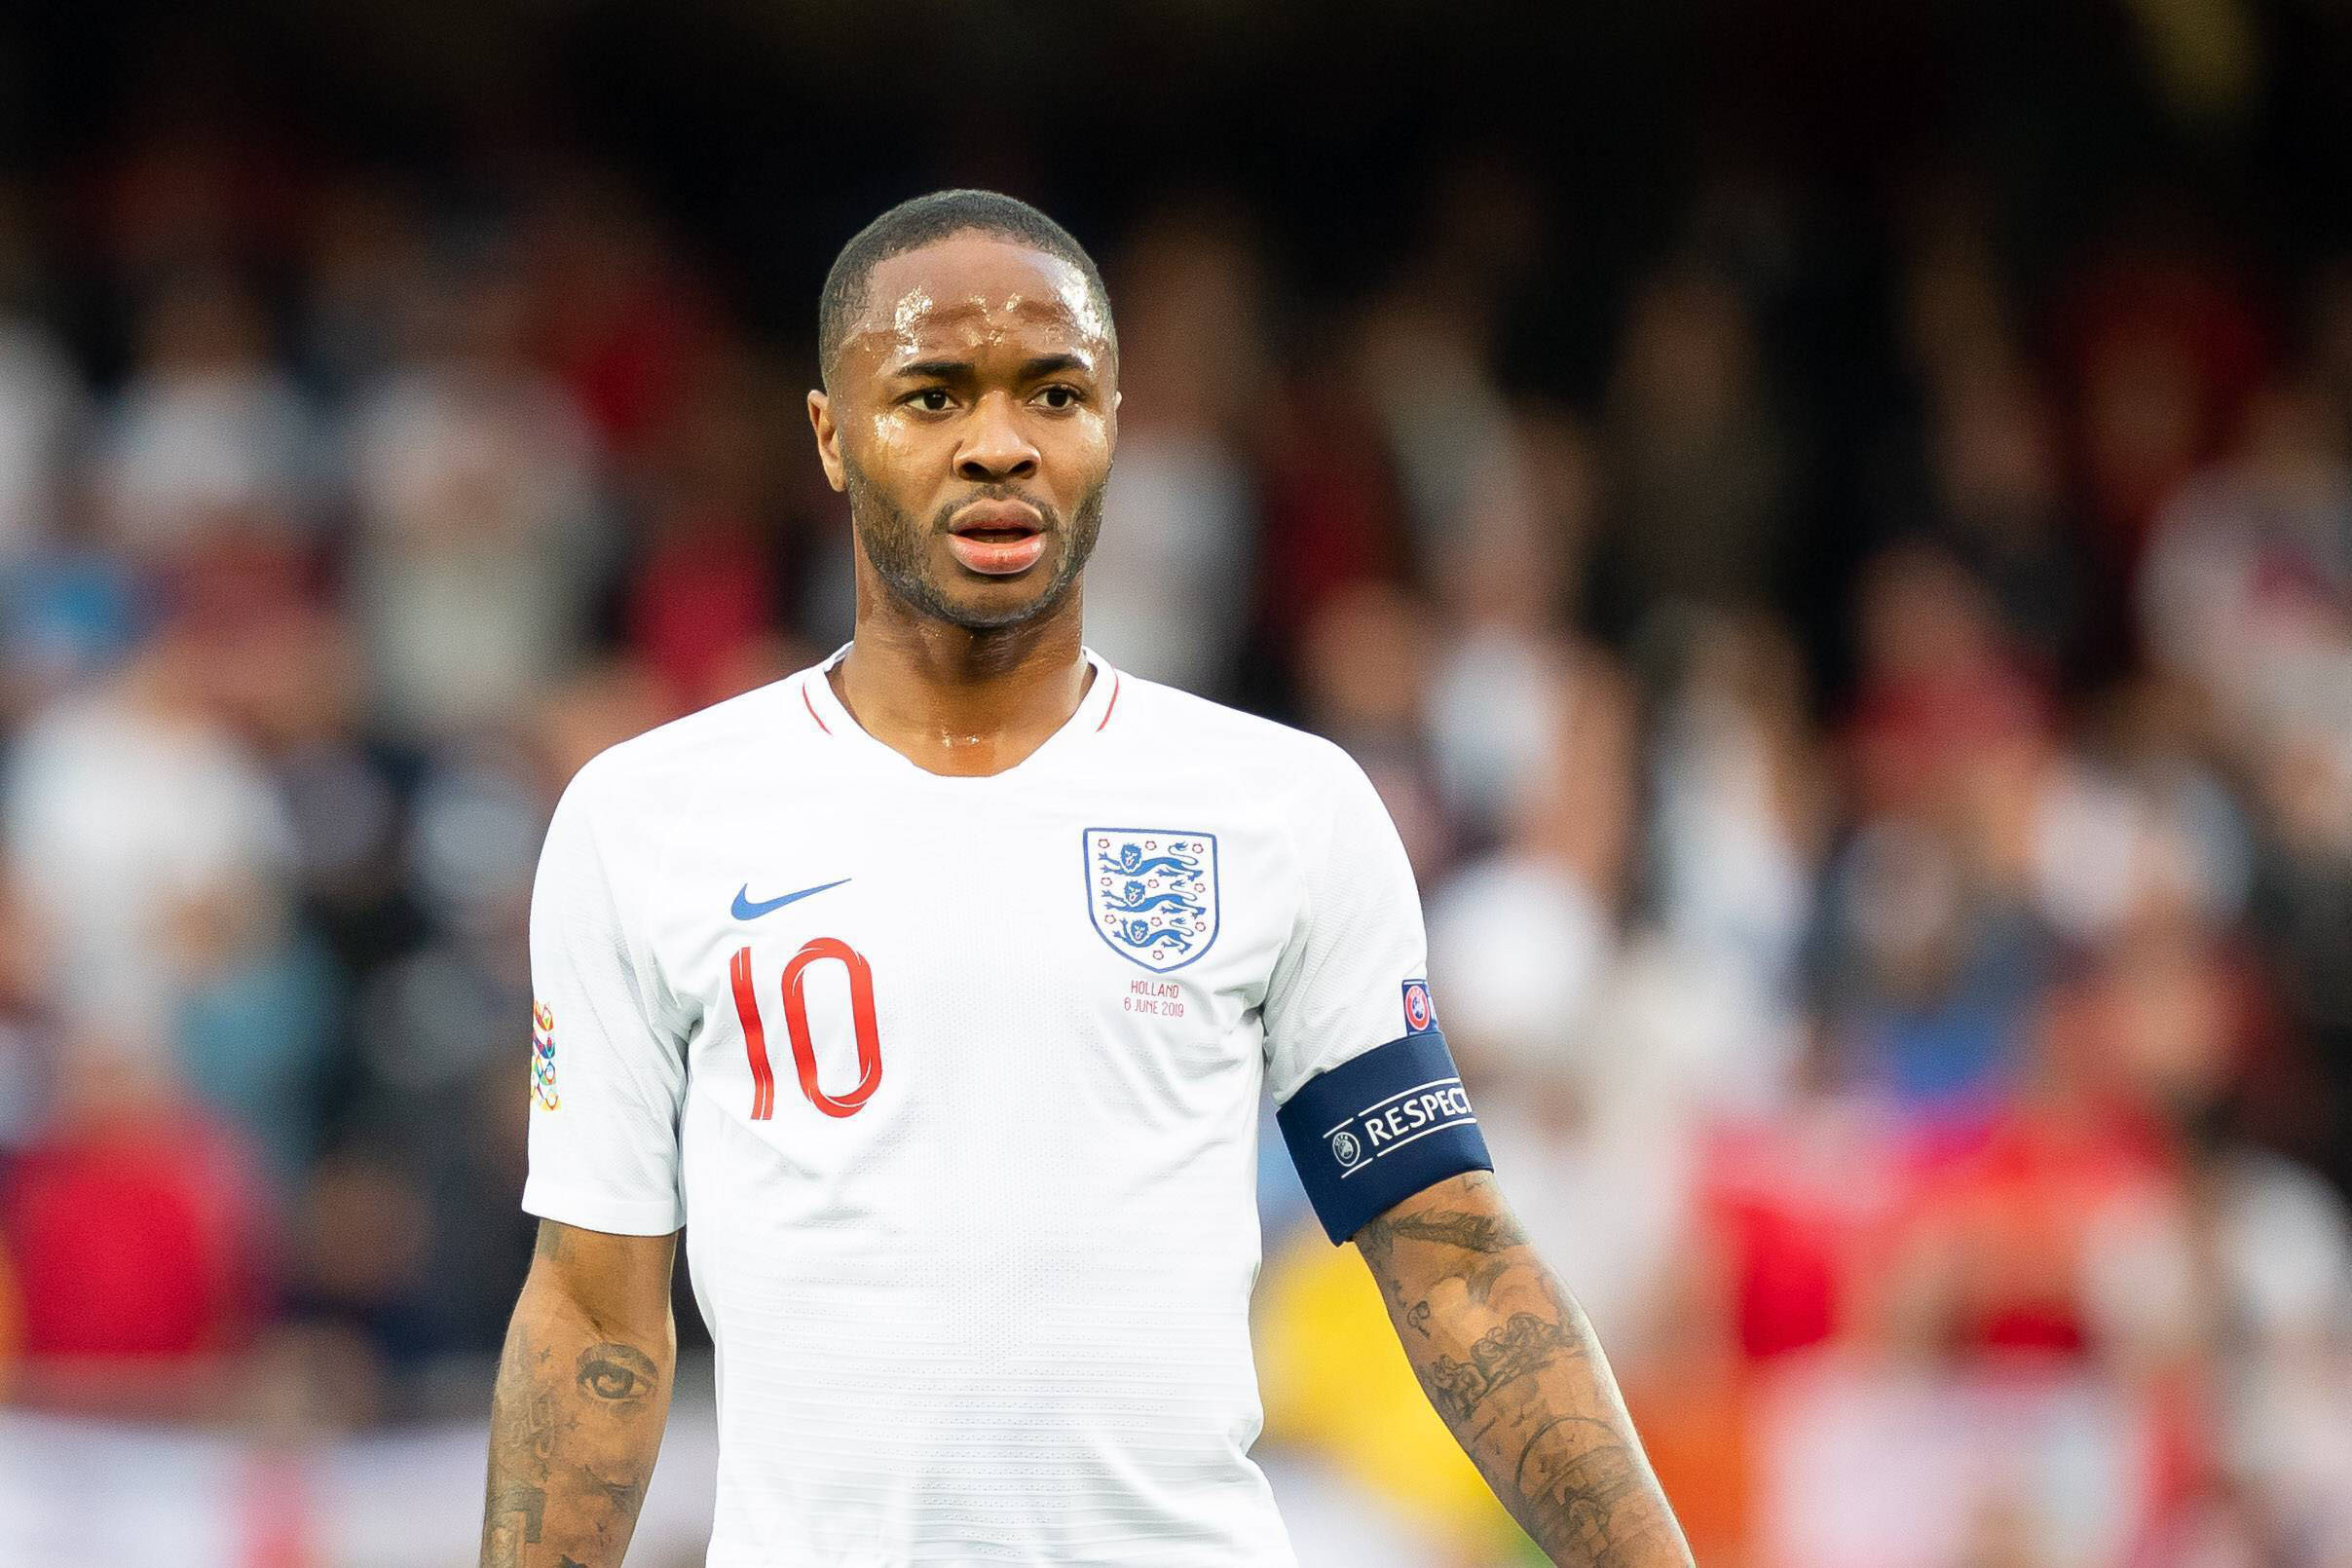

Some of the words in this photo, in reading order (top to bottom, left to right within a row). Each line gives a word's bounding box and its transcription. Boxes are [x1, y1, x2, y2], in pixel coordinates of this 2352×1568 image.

[1131, 980, 1179, 999] HOLLAND
[1124, 997, 1132, 1012] 6
[1134, 998, 1159, 1015] JUNE
[1161, 1001, 1184, 1018] 2019
[730, 937, 882, 1120] 10
